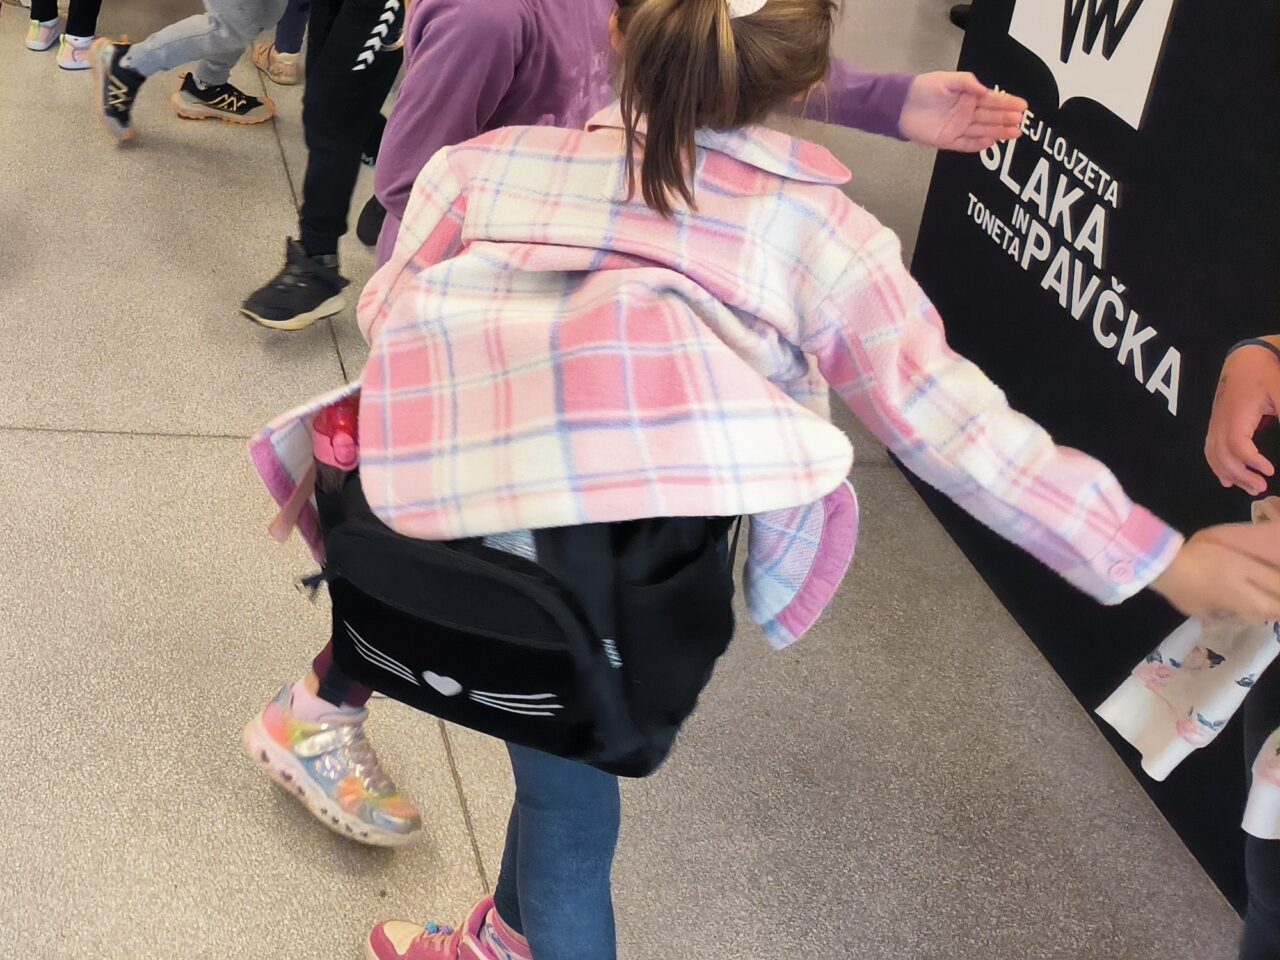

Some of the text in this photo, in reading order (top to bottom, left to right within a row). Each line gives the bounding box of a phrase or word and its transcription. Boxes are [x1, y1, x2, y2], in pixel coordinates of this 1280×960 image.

[1042, 127, 1119, 209] LOJZETA
[1011, 203, 1030, 235] IN
[967, 192, 1181, 417] TONETA PAVČKA
